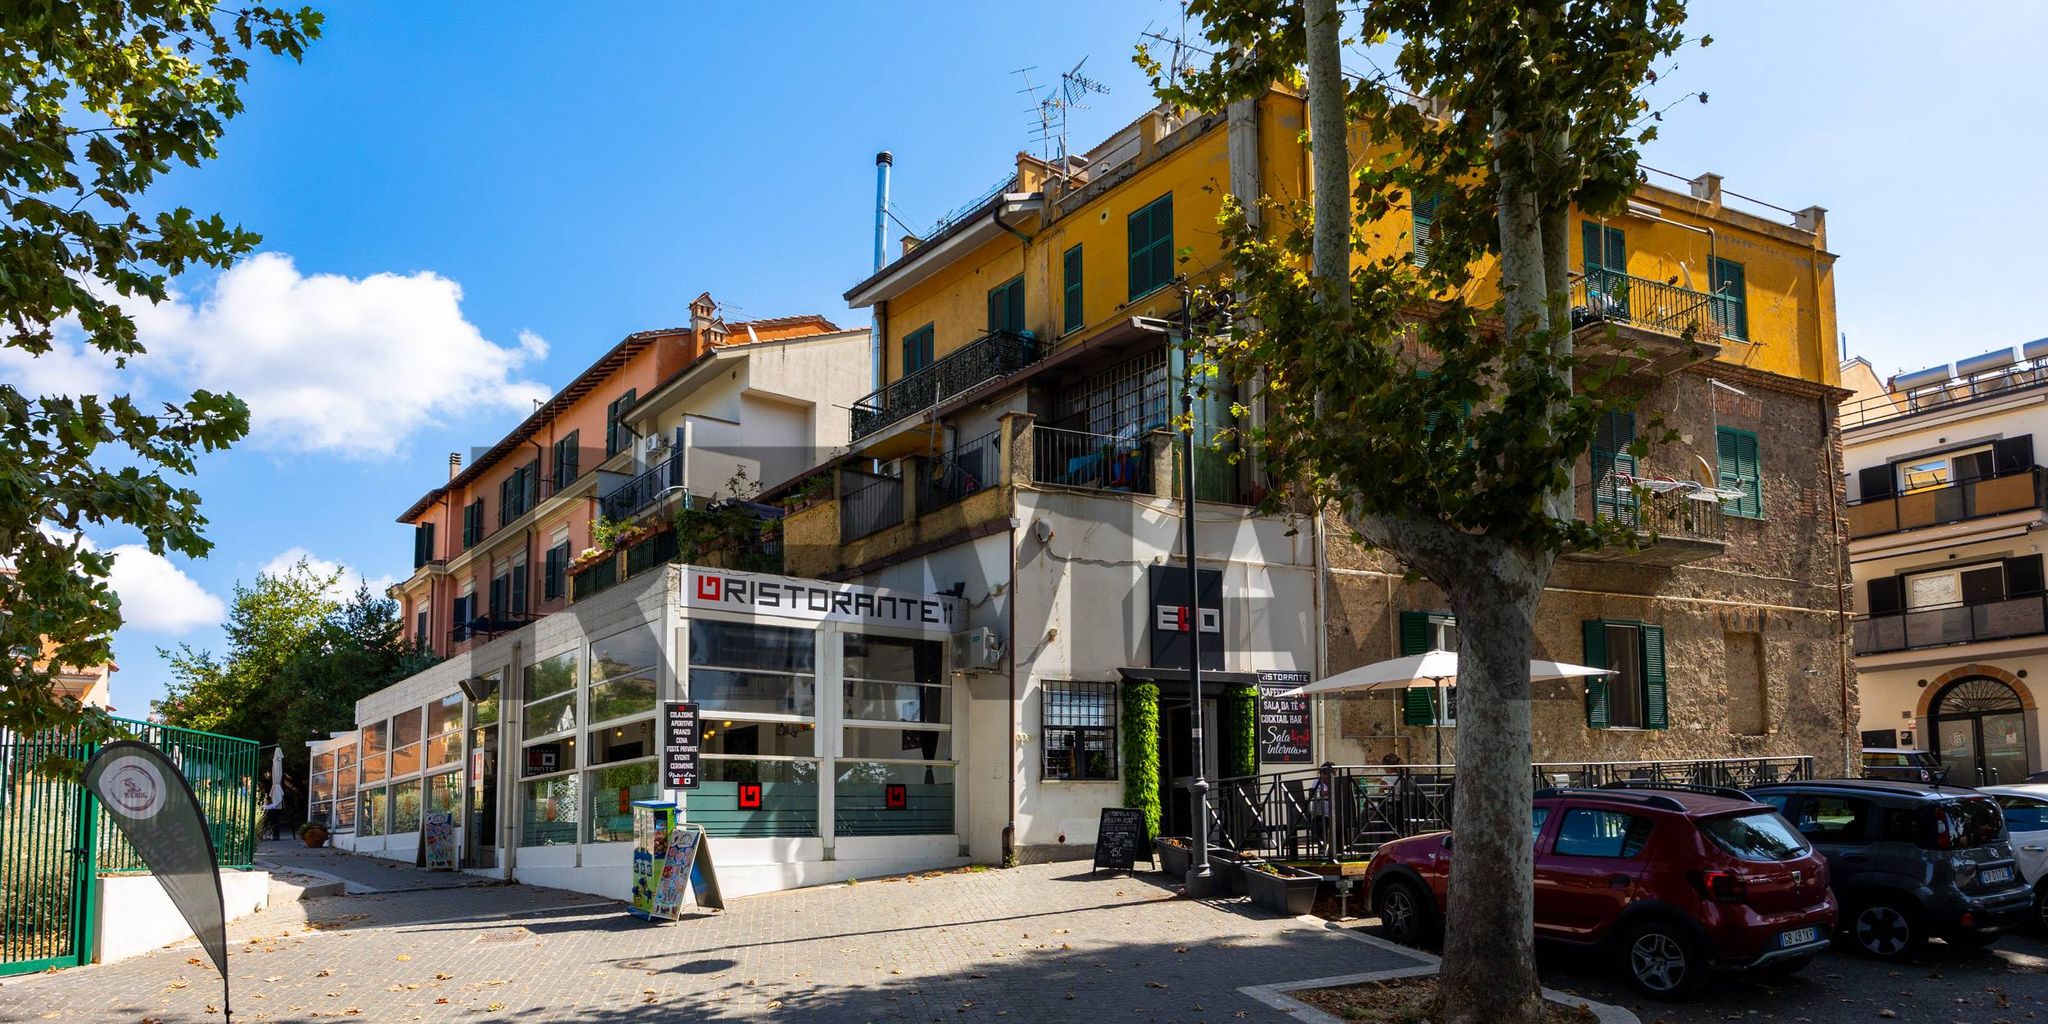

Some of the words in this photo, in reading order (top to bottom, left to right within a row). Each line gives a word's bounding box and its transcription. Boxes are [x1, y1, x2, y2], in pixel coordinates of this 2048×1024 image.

[724, 578, 940, 623] RISTORANTE
[1264, 701, 1280, 710] SALA
[1281, 702, 1290, 710] DA
[1261, 714, 1288, 724] COCKTAIL
[1290, 715, 1302, 724] BAR
[1262, 726, 1290, 744] Sala
[1267, 743, 1300, 755] interna
